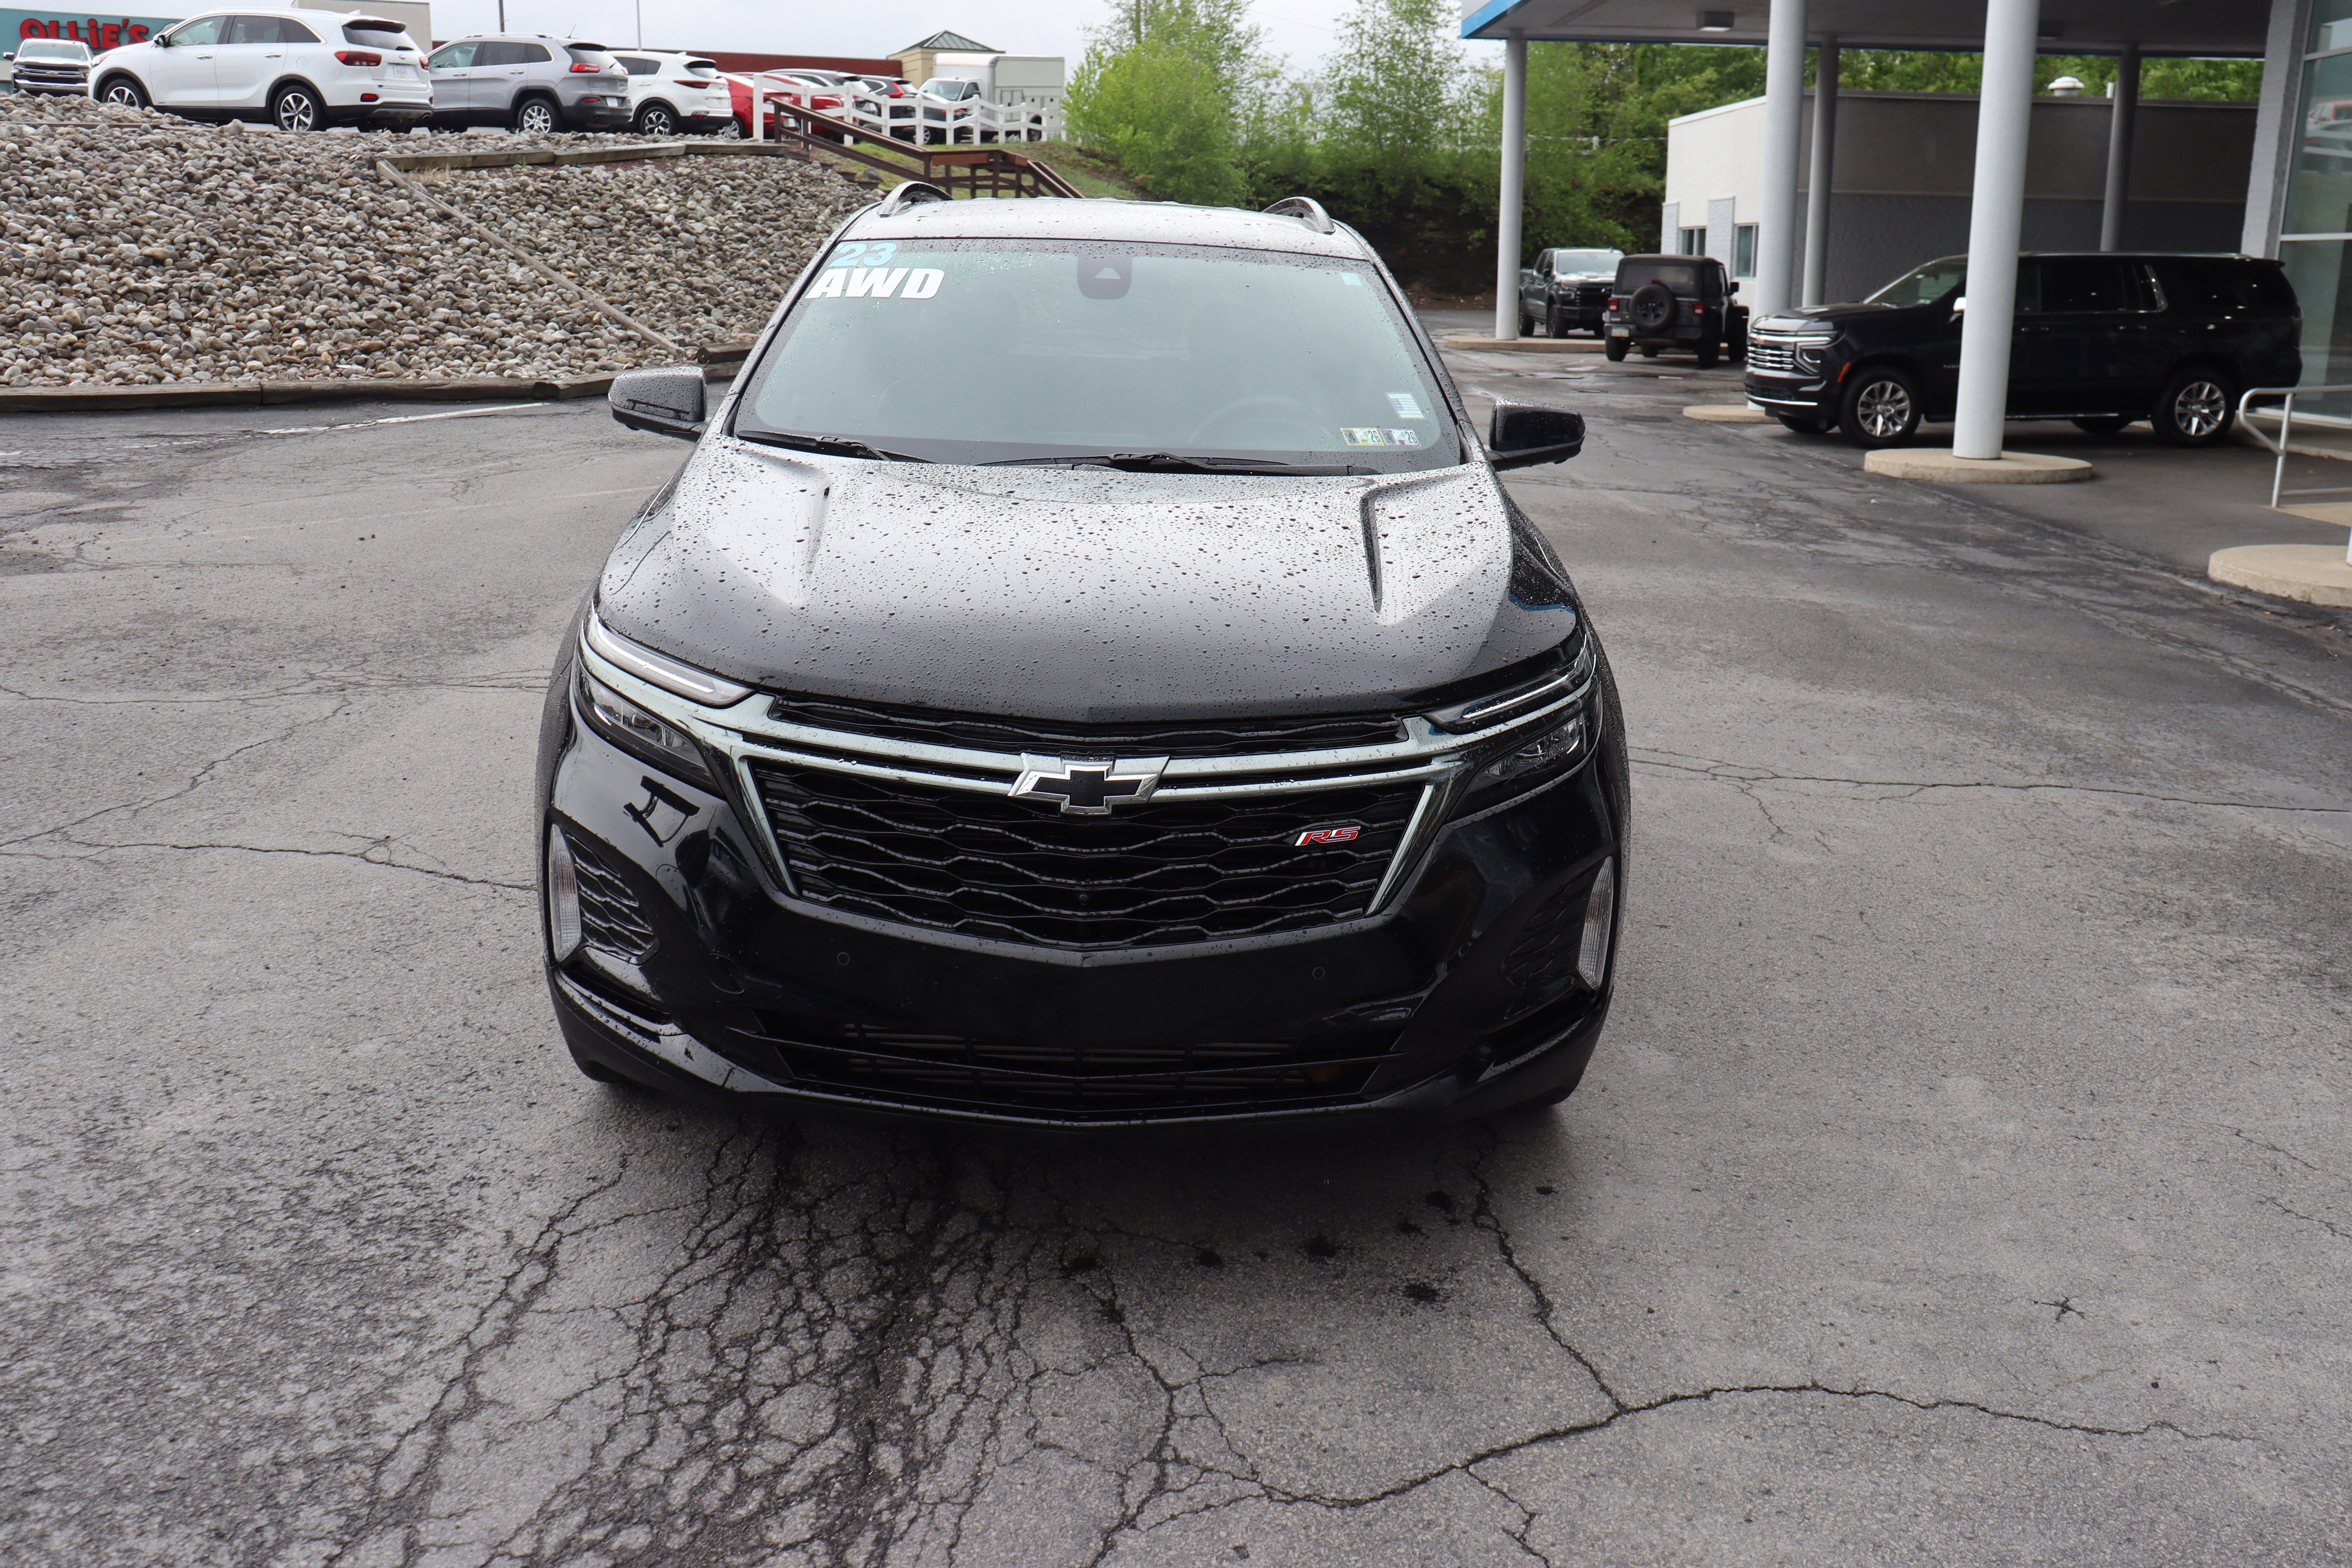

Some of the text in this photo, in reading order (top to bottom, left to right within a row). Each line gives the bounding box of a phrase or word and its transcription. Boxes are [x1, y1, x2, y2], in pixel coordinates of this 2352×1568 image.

[804, 267, 944, 299] AWD
[1368, 431, 1381, 443] 26
[1405, 431, 1418, 443] 26
[1295, 826, 1361, 846] RS
